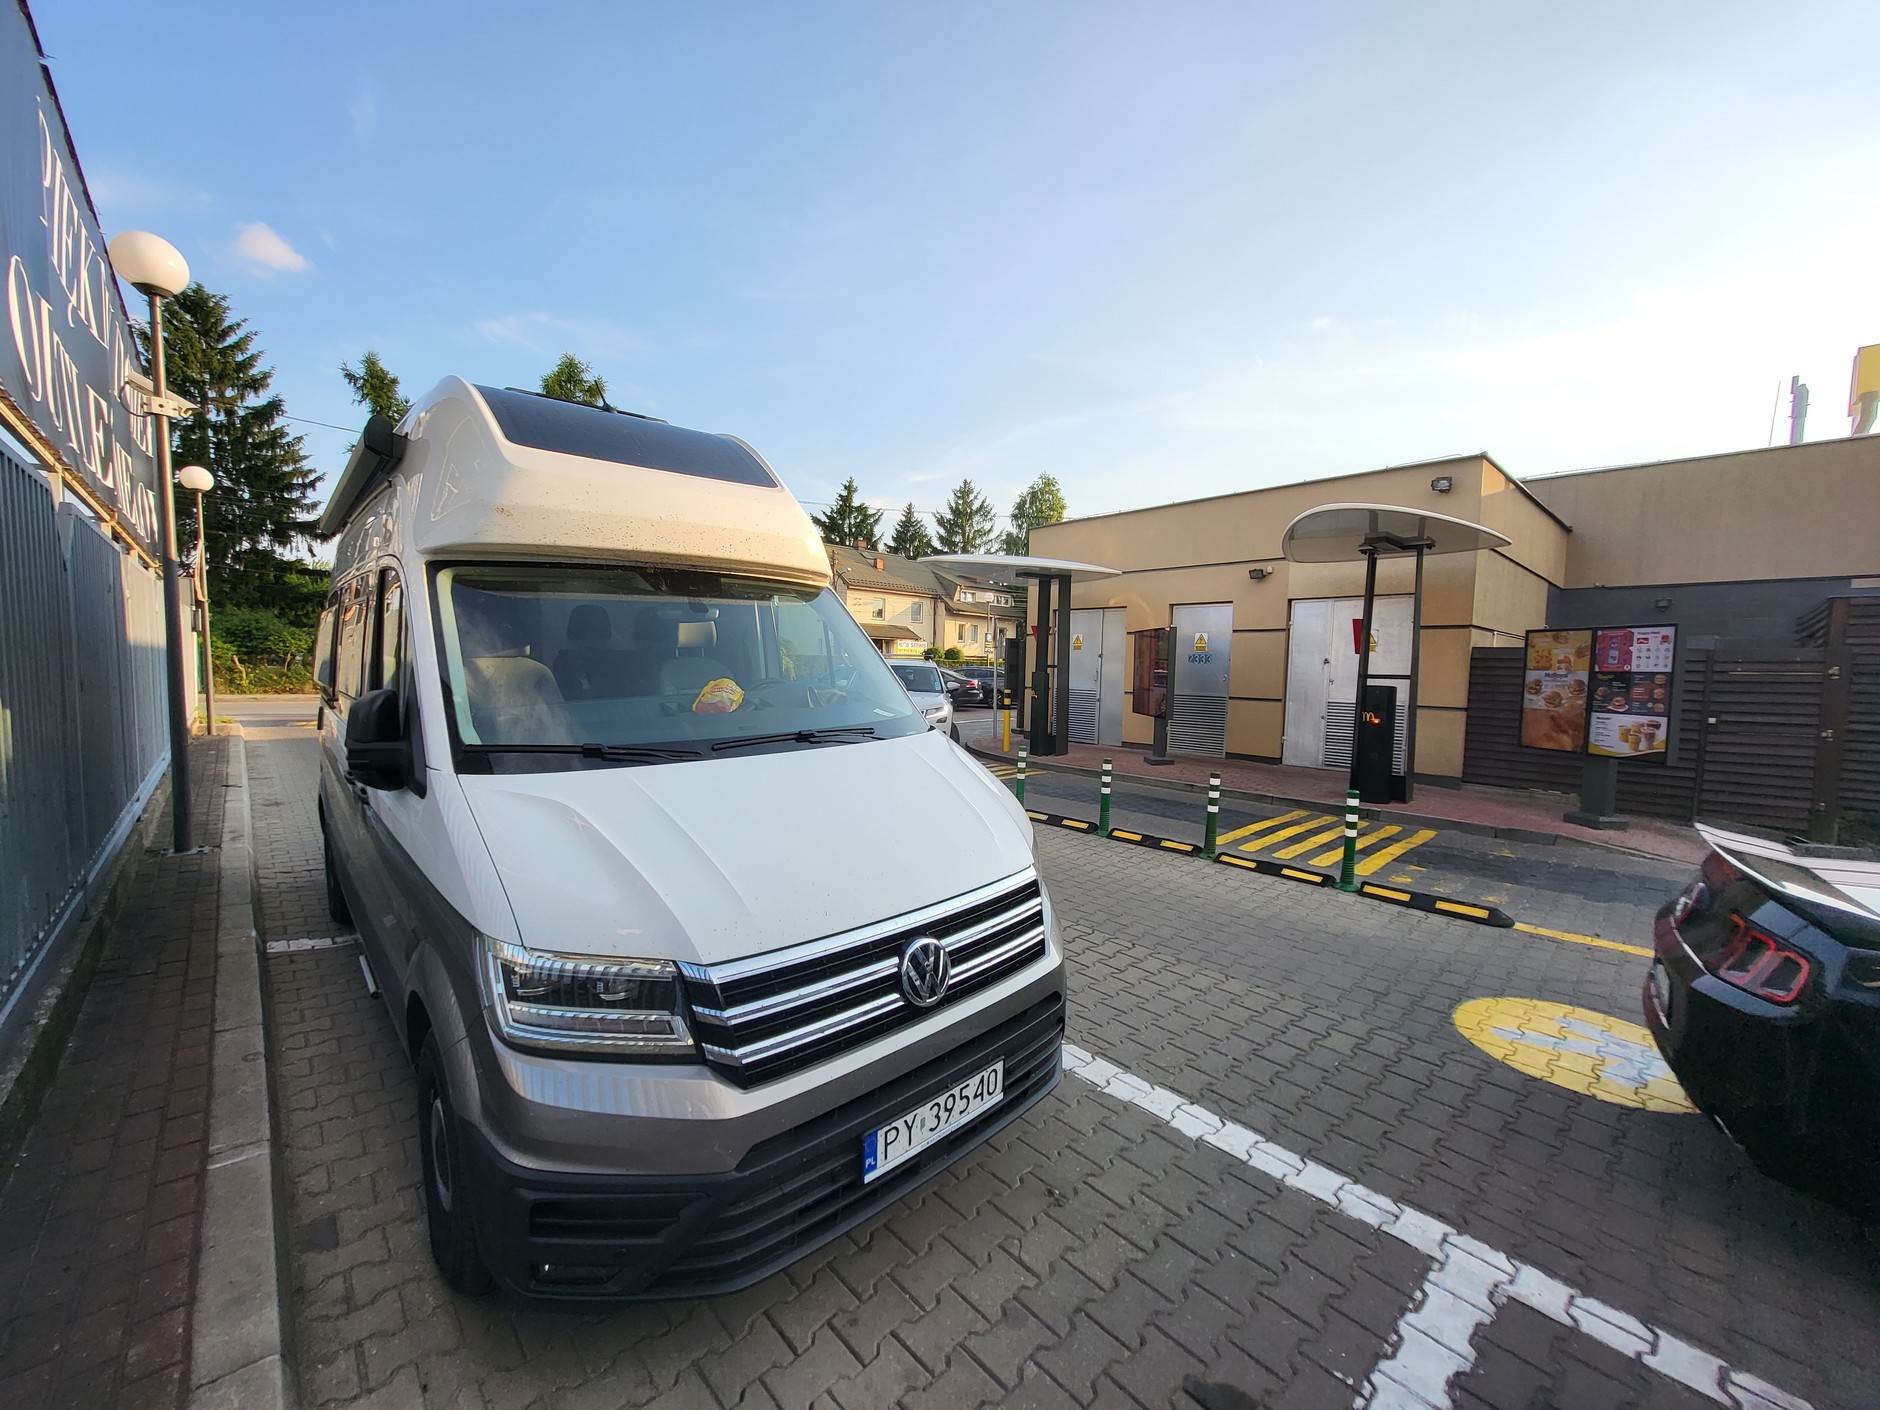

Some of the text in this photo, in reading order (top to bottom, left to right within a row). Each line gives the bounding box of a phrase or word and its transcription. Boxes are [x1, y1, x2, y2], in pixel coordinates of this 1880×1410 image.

[884, 1113, 919, 1161] PY
[928, 1068, 998, 1133] 39540
[865, 1156, 876, 1169] PL
